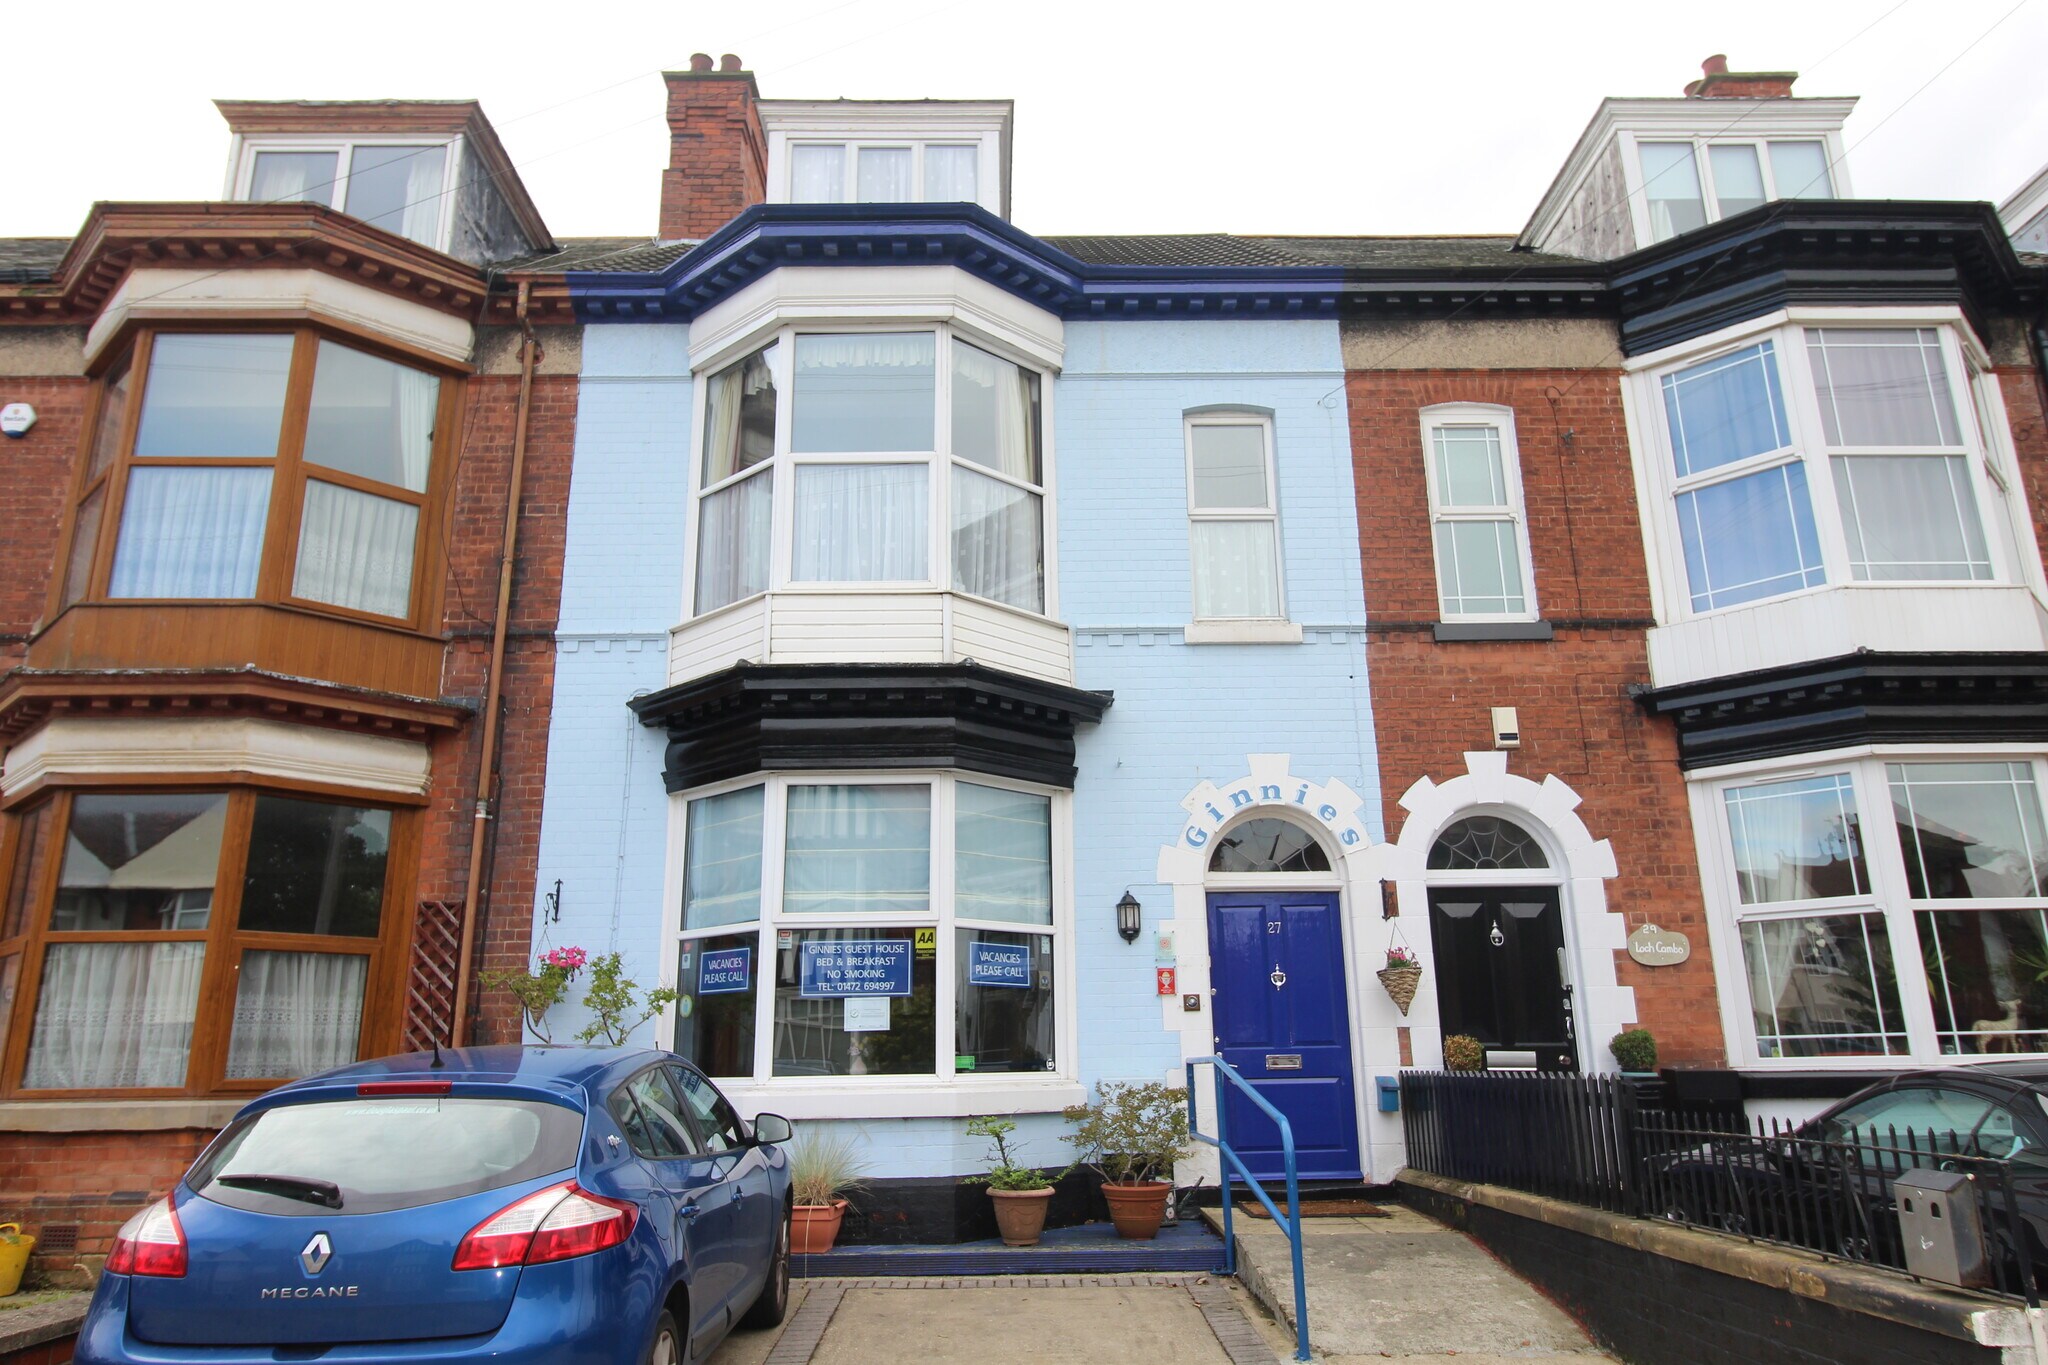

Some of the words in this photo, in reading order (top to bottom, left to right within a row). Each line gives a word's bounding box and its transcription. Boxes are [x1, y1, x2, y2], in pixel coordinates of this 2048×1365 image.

[1185, 783, 1360, 847] Ginnies
[1267, 921, 1282, 934] 27
[1642, 924, 1657, 934] 29
[917, 932, 934, 944] AA
[808, 945, 842, 954] GINNIES
[845, 945, 873, 954] GUEST
[875, 944, 905, 953] HOUSE
[1635, 941, 1655, 953] Loch
[708, 957, 742, 970] VACANCIES
[816, 957, 833, 966] BED
[836, 958, 843, 966] &
[847, 957, 896, 966] BREAKFAST
[979, 951, 1020, 964] VACANCIES
[827, 970, 841, 978] NO
[844, 969, 885, 978] SMOKING
[975, 965, 1002, 976] PLEASE
[1004, 966, 1024, 977] CALL
[704, 972, 726, 984] PLEASE
[727, 971, 744, 982] CALL
[817, 983, 834, 991] TEL:
[837, 982, 861, 991] 01472
[864, 982, 895, 990] 694997
[260, 1285, 359, 1299] MEGANE
